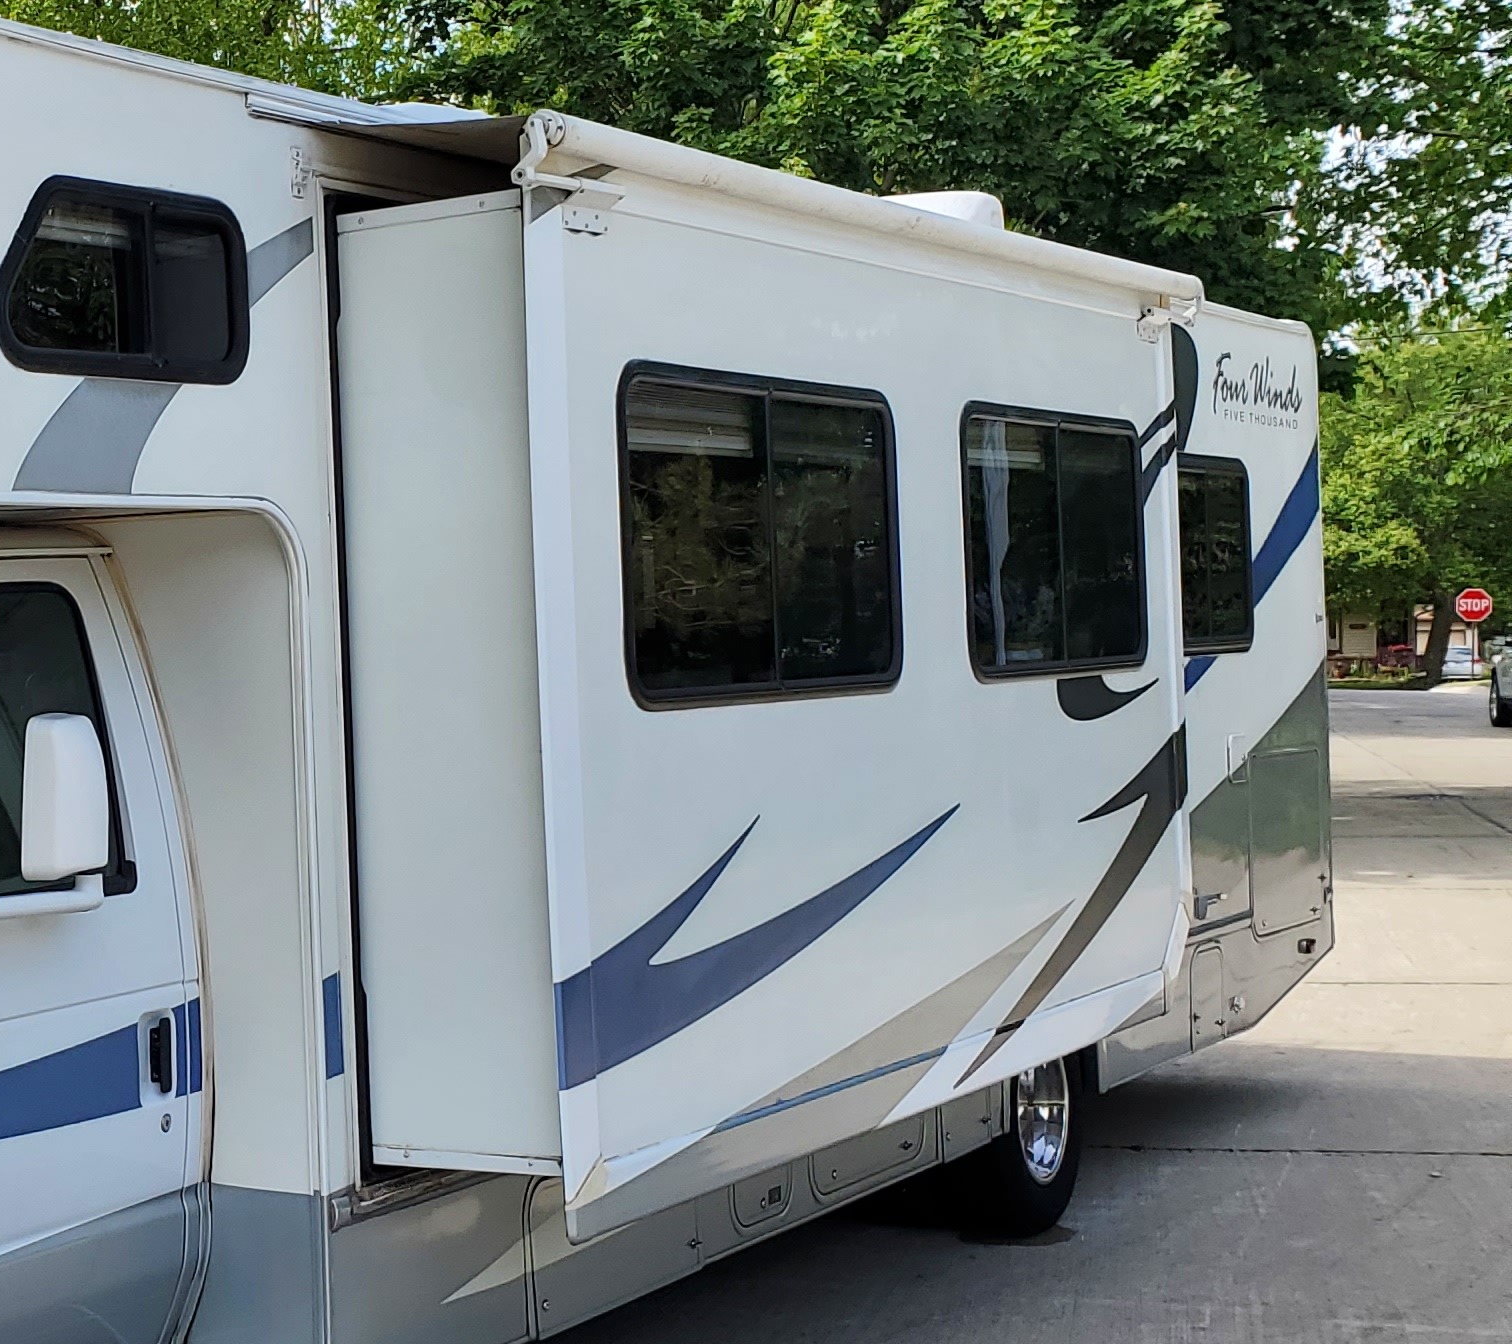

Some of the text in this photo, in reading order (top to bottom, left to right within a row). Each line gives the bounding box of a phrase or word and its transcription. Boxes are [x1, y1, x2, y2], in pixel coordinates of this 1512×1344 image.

[1212, 351, 1303, 415] Four Winds
[1223, 409, 1298, 430] FIVE THOUSAND
[1458, 598, 1490, 612] STOP
